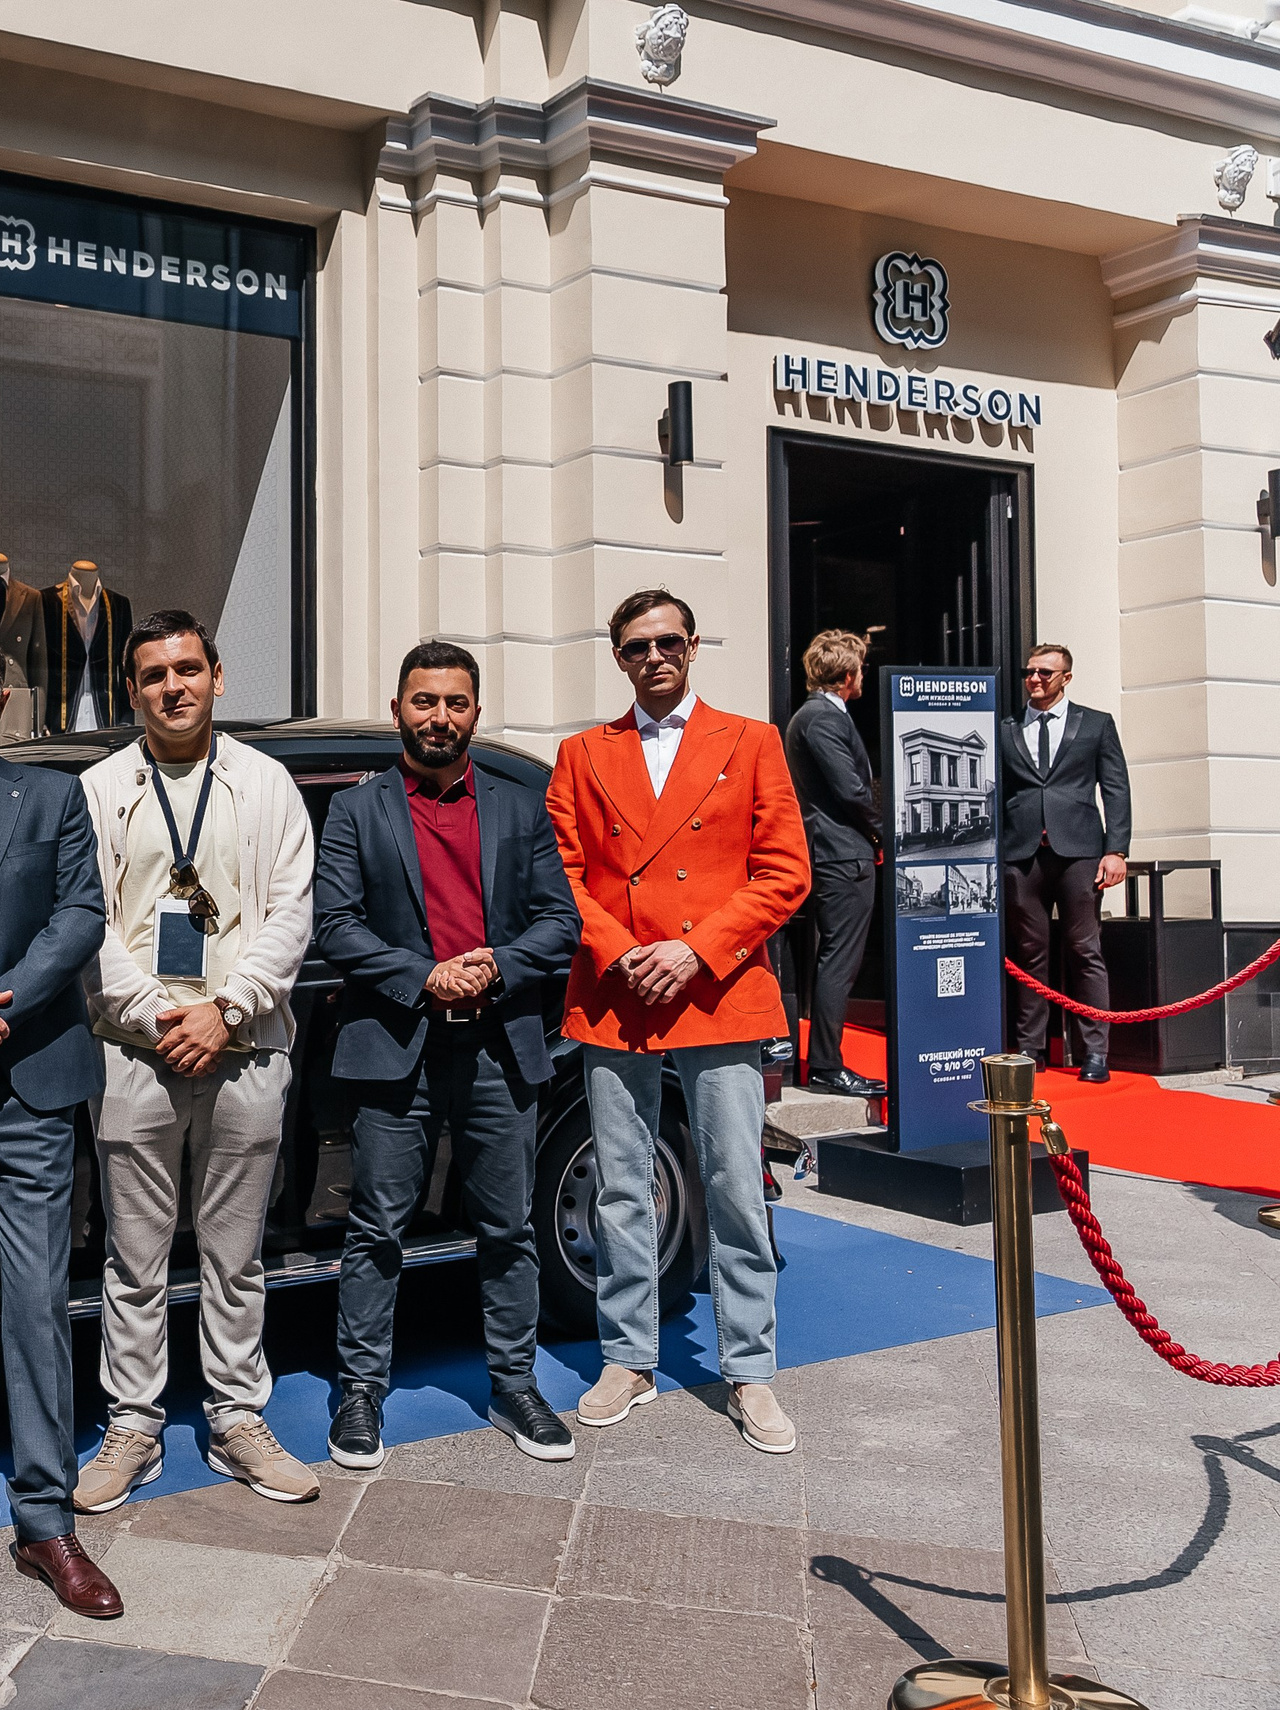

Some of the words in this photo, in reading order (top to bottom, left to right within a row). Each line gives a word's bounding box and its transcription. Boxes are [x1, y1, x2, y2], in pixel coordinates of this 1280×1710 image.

[47, 236, 287, 300] HENDERSON
[776, 354, 1042, 428] HENDERSON
[916, 680, 987, 693] HENDERSON
[918, 1048, 964, 1062] КУЗНЕЦКИЙ
[964, 1047, 985, 1058] МОСТ
[944, 1061, 961, 1072] 9/10
